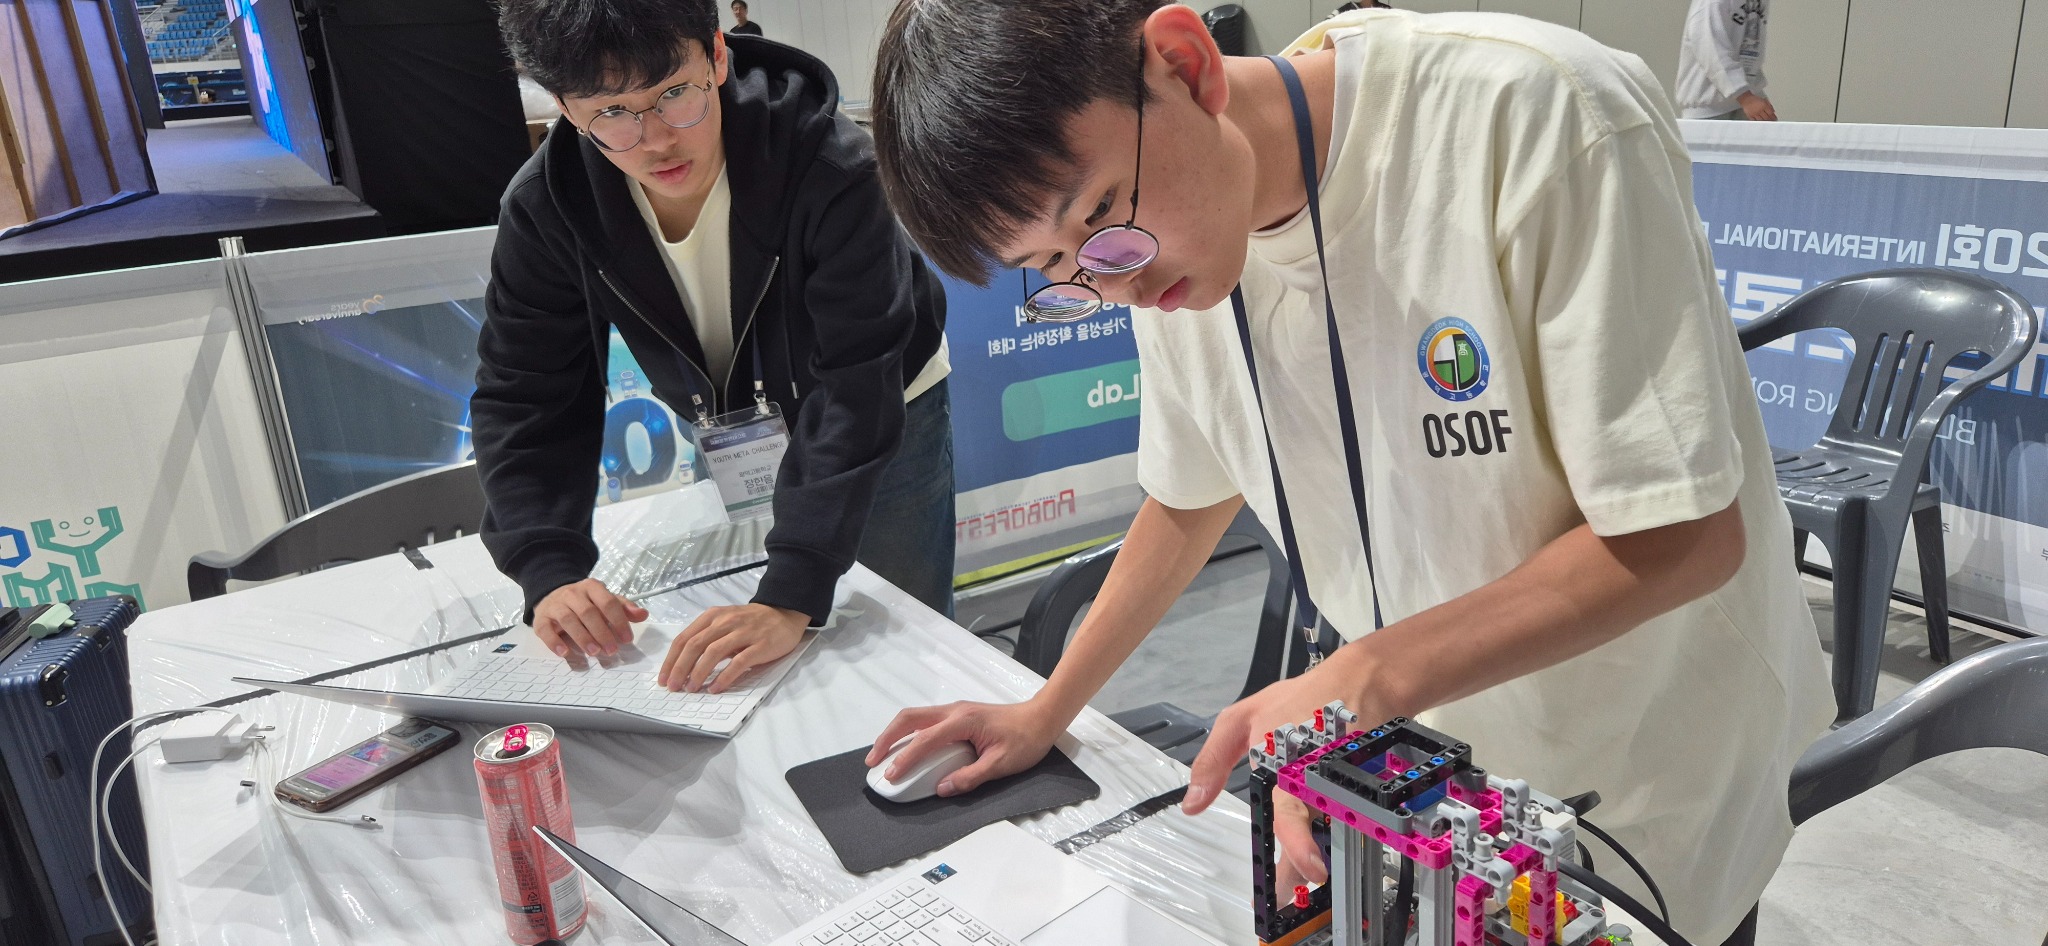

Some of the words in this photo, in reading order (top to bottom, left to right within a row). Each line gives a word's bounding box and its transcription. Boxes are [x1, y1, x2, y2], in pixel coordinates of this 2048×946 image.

[1423, 410, 1513, 458] OSOF
[712, 454, 733, 464] YOUTH
[733, 451, 751, 460] META
[751, 441, 785, 455] CHALLENGE
